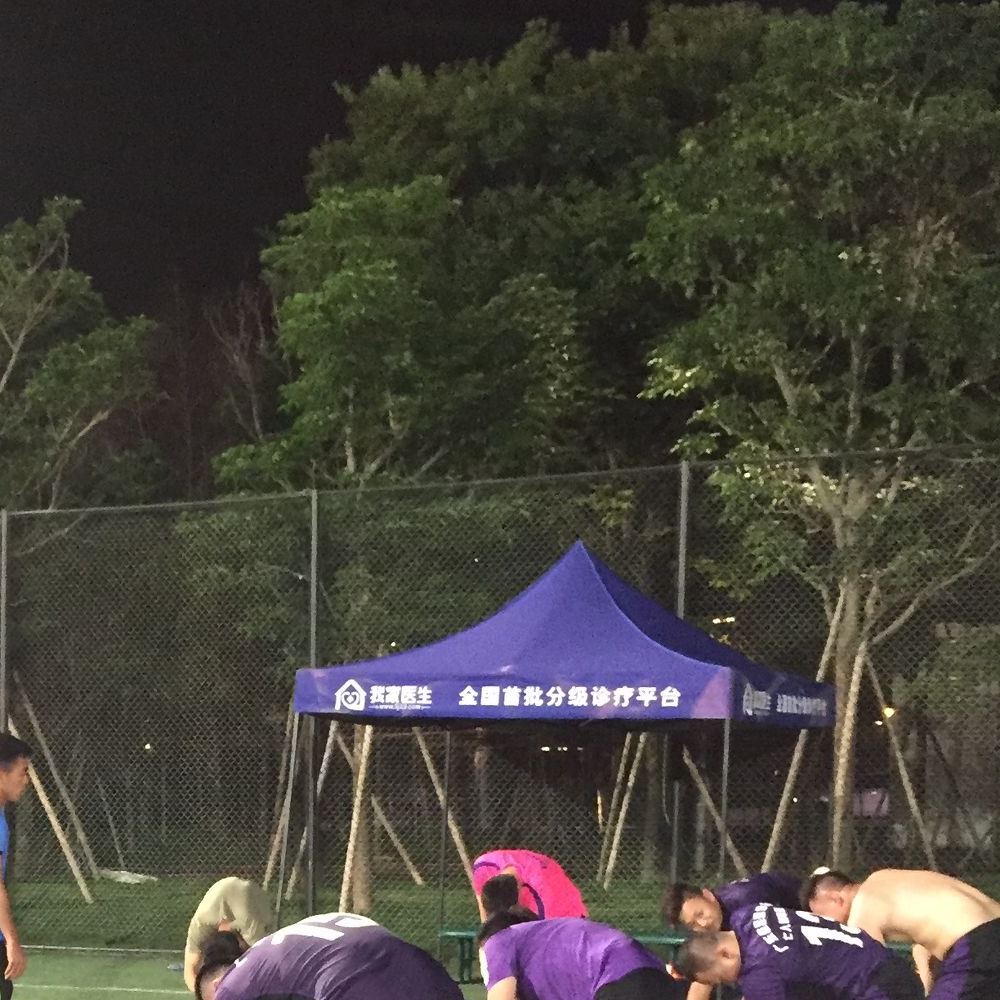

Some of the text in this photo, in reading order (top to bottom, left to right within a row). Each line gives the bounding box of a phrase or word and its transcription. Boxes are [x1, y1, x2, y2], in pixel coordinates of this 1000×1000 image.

[458, 685, 682, 708] 全国首批分级诊疗平台
